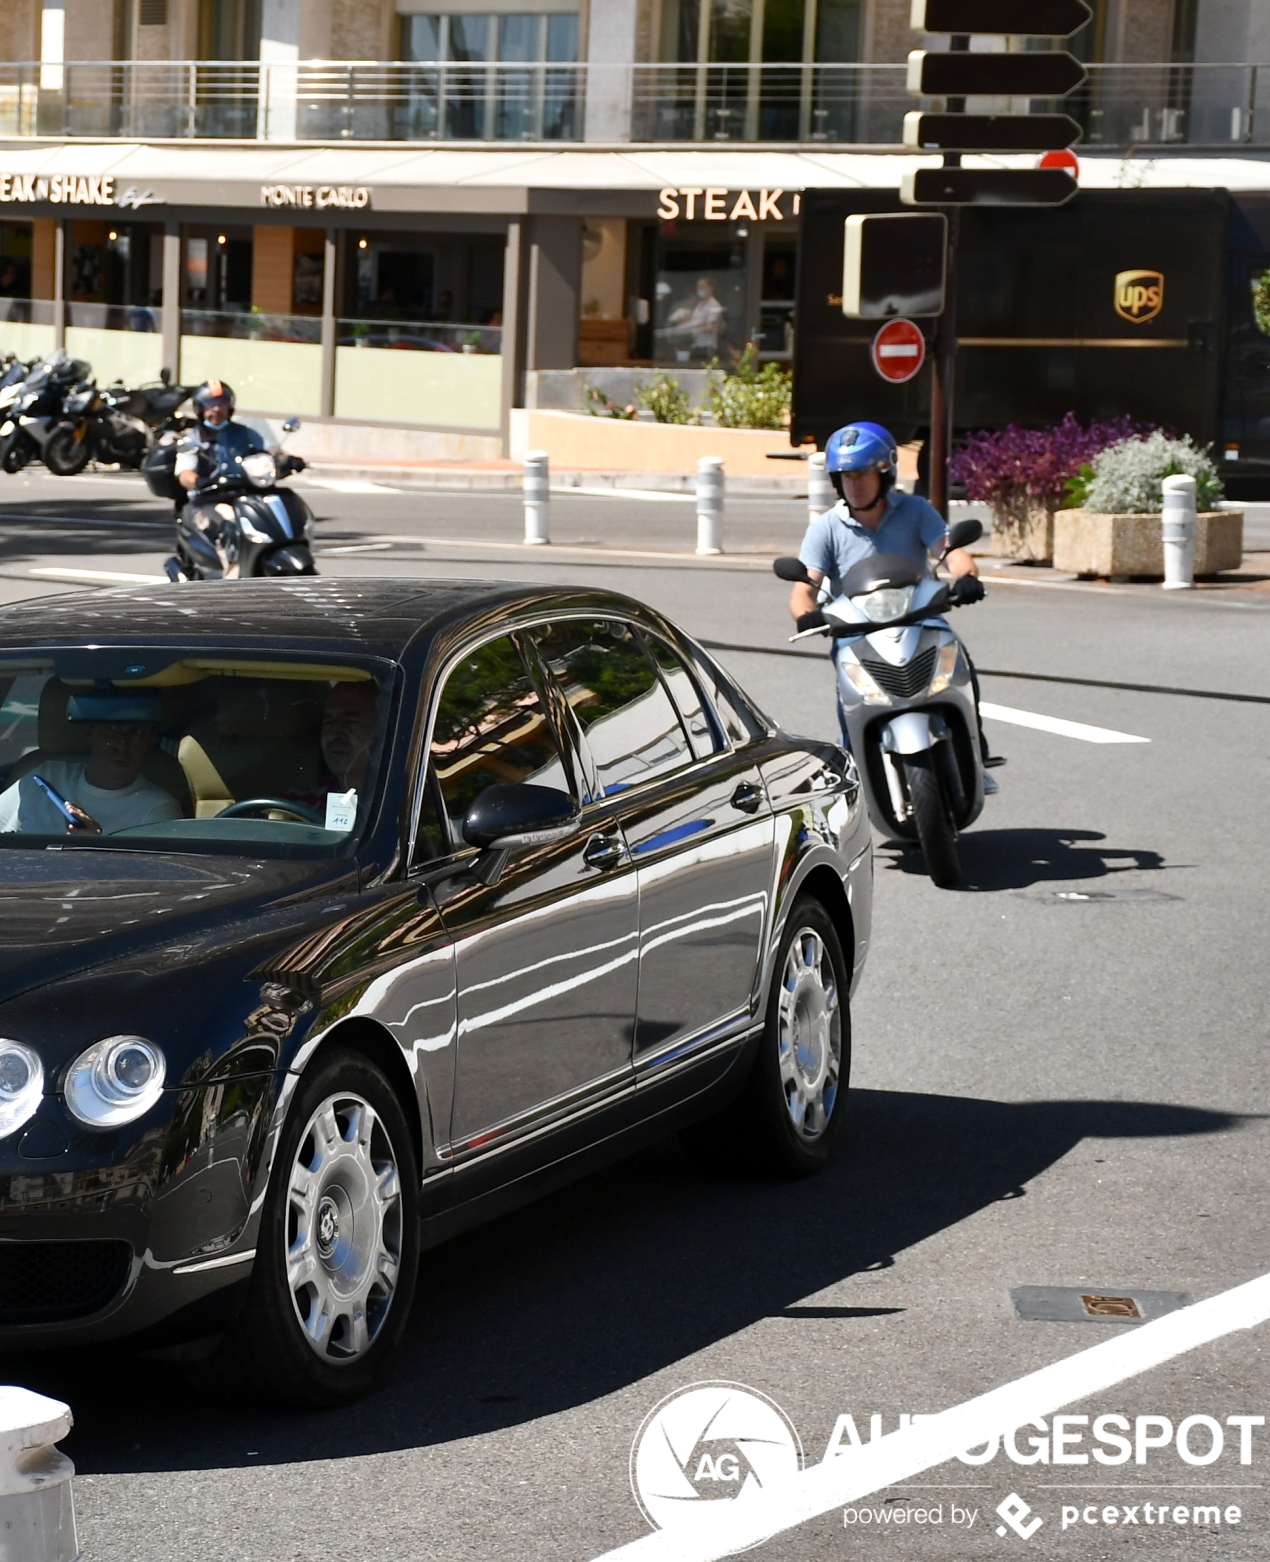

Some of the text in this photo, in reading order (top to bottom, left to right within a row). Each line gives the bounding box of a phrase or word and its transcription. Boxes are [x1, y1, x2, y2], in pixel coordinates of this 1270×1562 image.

[50, 174, 115, 205] SHAKE
[260, 184, 369, 209] MONTE CARLO
[657, 187, 785, 221] STEAK
[1119, 285, 1160, 316] ups
